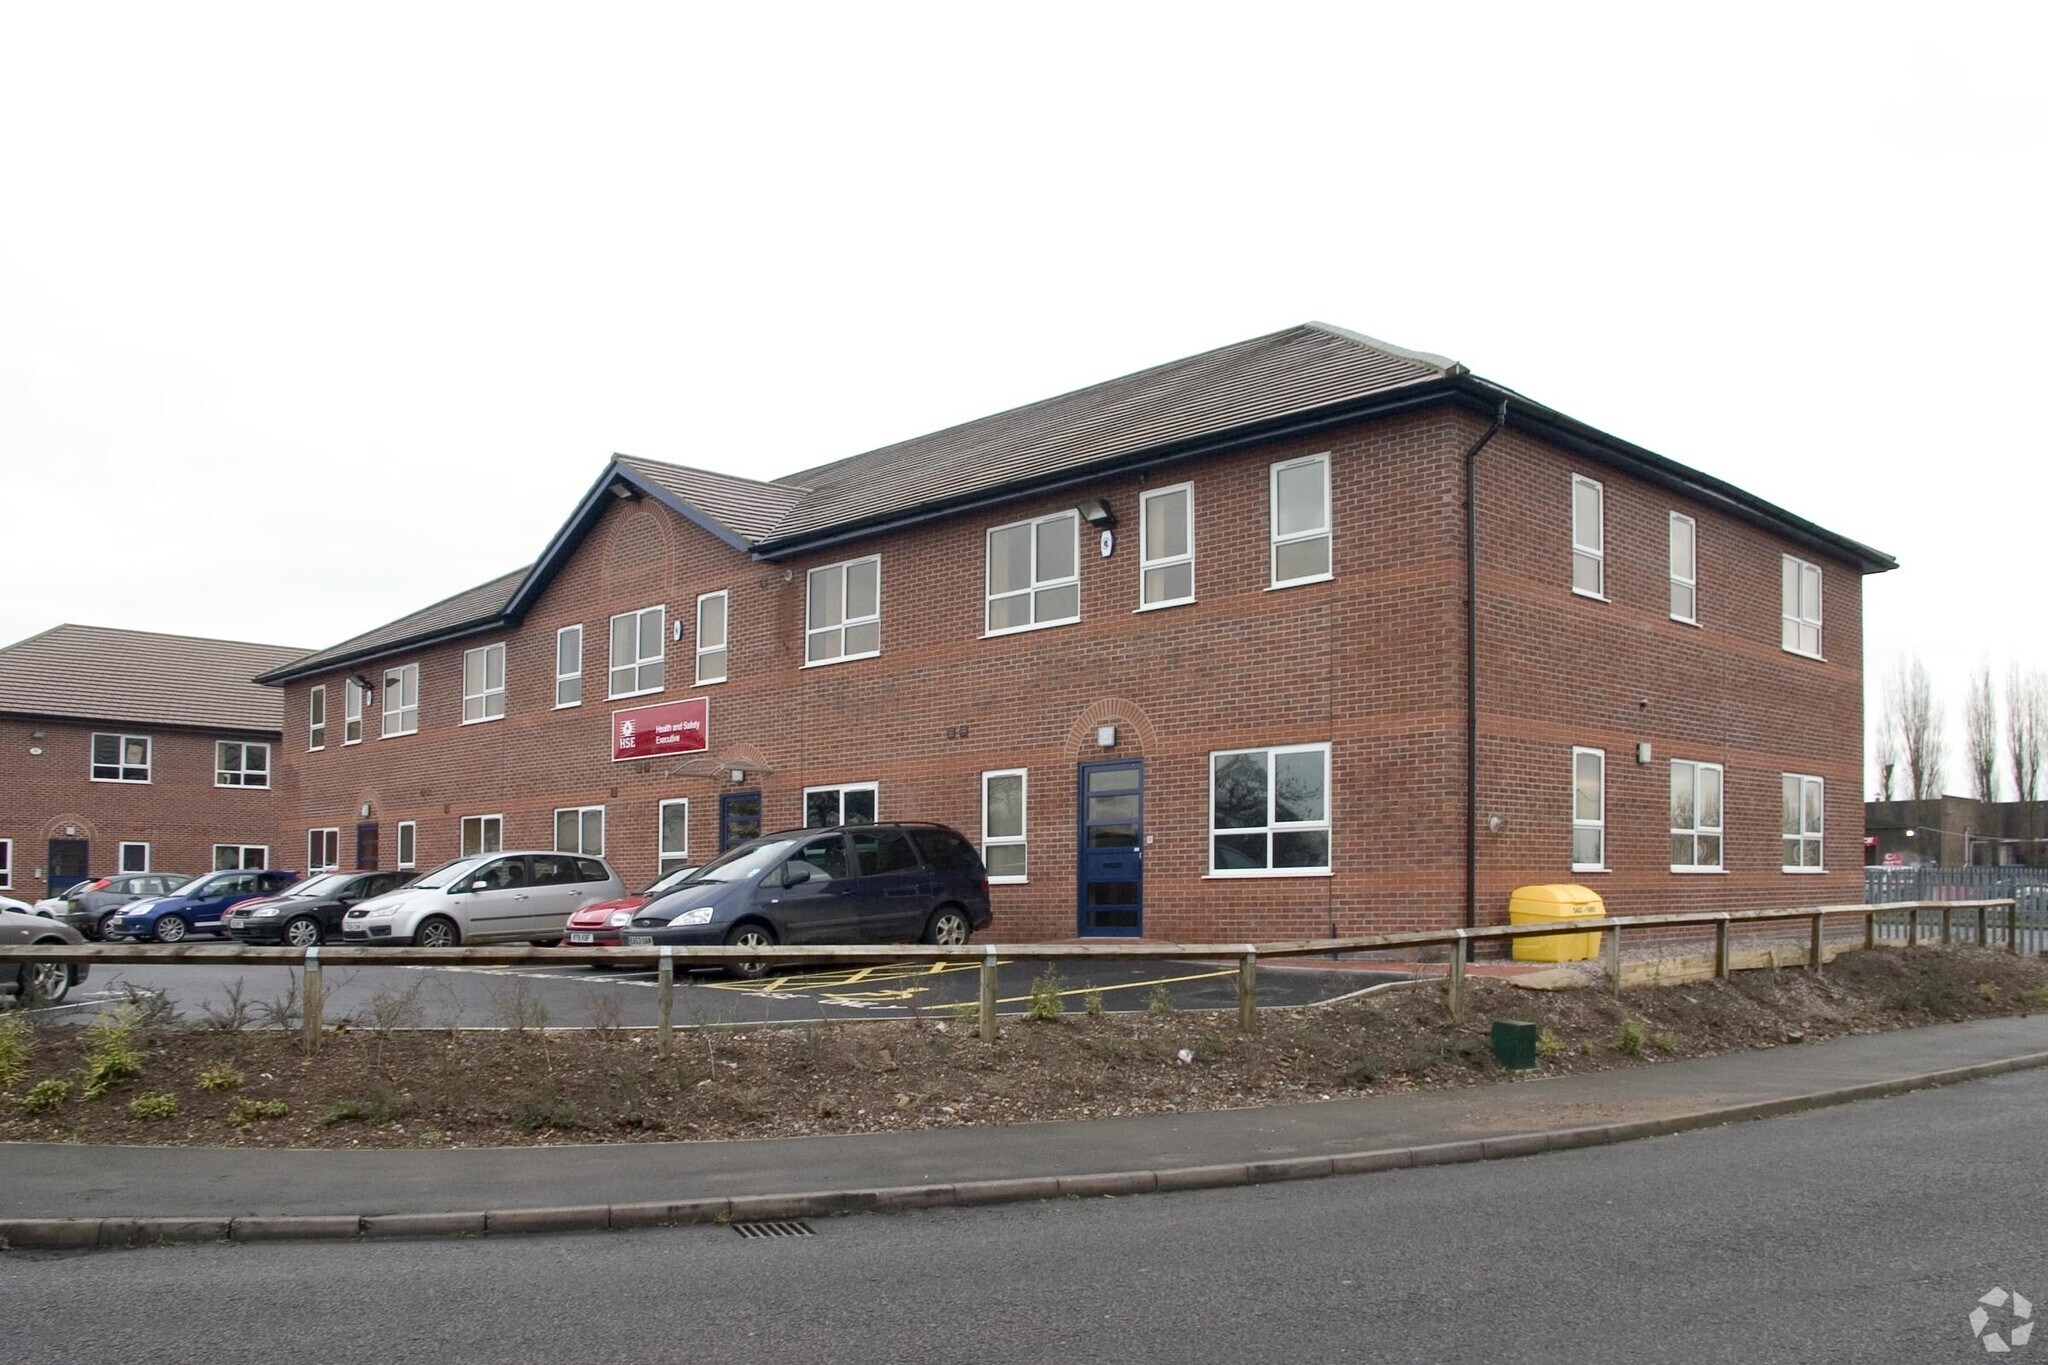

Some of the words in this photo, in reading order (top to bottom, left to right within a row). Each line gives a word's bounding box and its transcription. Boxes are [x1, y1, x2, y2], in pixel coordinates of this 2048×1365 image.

[656, 724, 672, 733] Health
[673, 722, 682, 731] and
[683, 720, 700, 730] Safety
[620, 737, 635, 749] HSE
[656, 735, 680, 744] Executive
